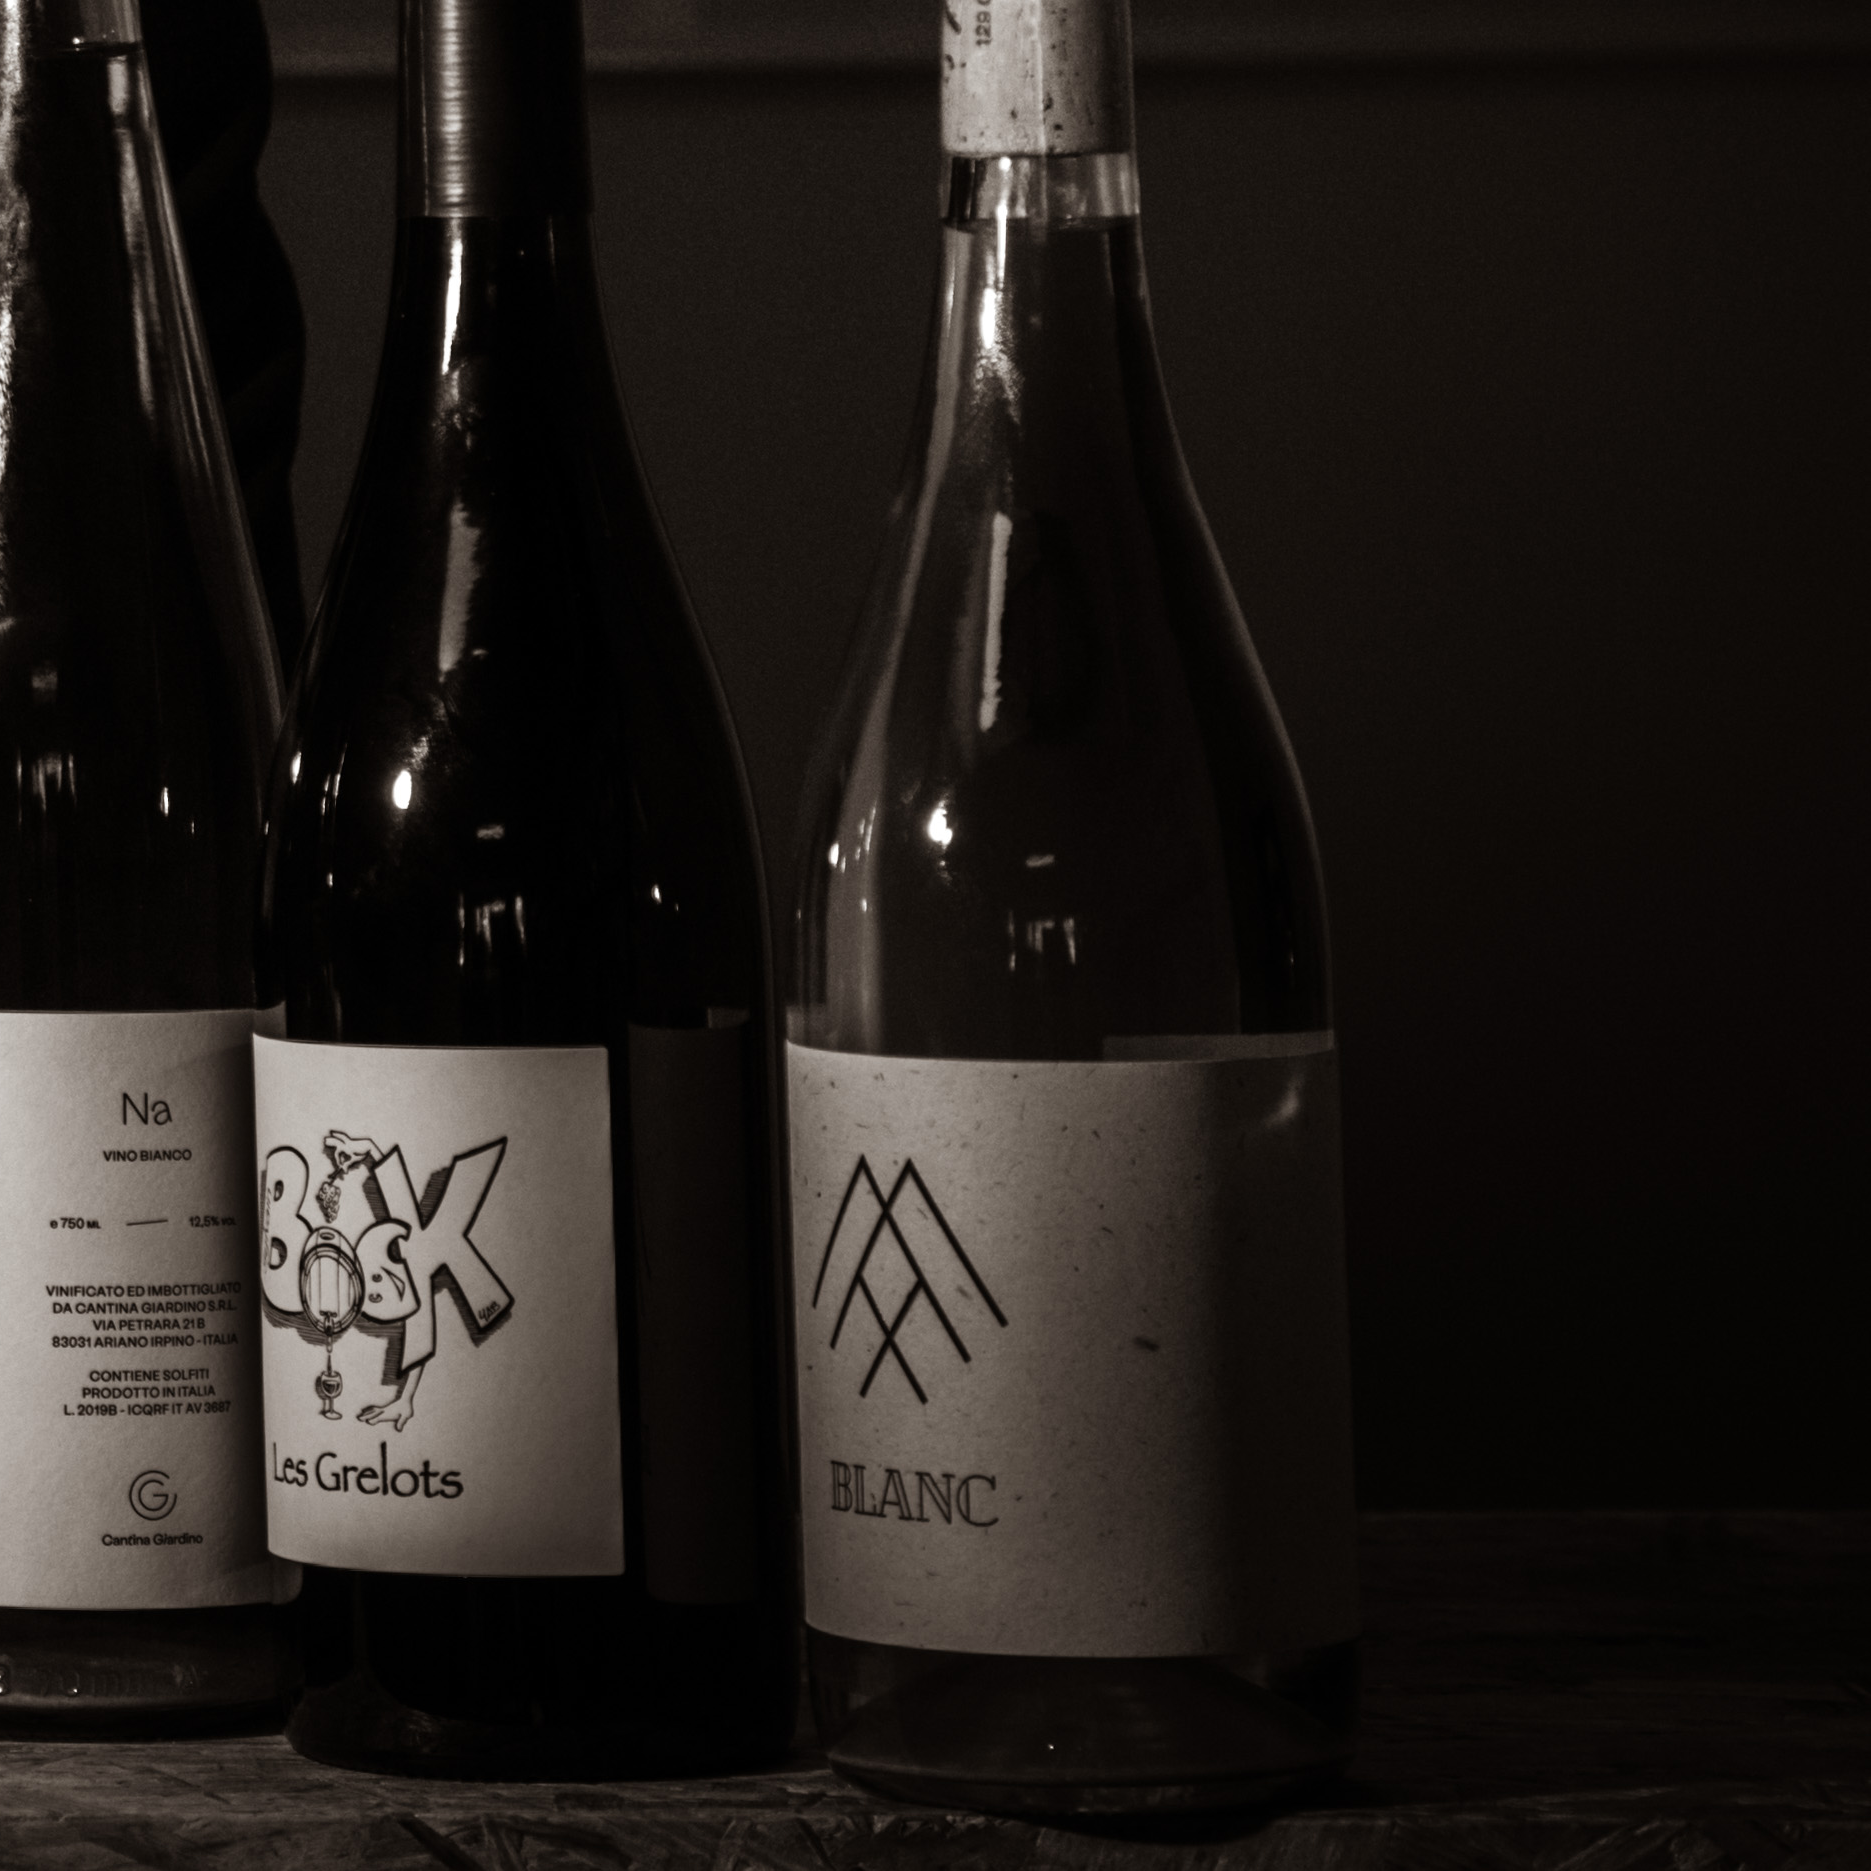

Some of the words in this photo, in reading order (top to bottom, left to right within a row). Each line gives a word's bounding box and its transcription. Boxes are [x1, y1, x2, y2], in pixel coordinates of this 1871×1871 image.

[122, 1091, 173, 1126] Na
[102, 1149, 138, 1163] VINO
[140, 1148, 193, 1162] BIANCO
[60, 1216, 85, 1230] 750
[45, 1284, 125, 1298] VINIFICATO
[126, 1284, 146, 1298] ED
[147, 1281, 242, 1297] IMBOTTIGLIATO
[52, 1301, 73, 1315] DA
[75, 1301, 139, 1315] CANTINA
[140, 1300, 206, 1315] GIARDINO
[92, 1319, 116, 1332] VIA
[118, 1318, 181, 1332] PETRARA
[51, 1335, 92, 1349] 83031
[93, 1335, 149, 1349] ARIANO
[150, 1334, 195, 1348] IRPINO
[203, 1332, 240, 1346] ITALIA
[88, 1369, 161, 1383] CONTIENE
[162, 1368, 210, 1382] SOLFITI
[82, 1386, 160, 1400] PRODOTTO
[162, 1386, 175, 1399] IN
[177, 1385, 216, 1398] ITALIA
[63, 1404, 75, 1416] L.
[77, 1403, 118, 1416] 2019B
[127, 1403, 171, 1417] ICQRF
[172, 1402, 183, 1415] IT
[185, 1402, 203, 1415] AV
[271, 1440, 310, 1488] Les
[314, 1440, 465, 1500] Grelots
[829, 1458, 1000, 1530] BLANC
[101, 1533, 151, 1547] Cantina
[152, 1532, 204, 1547] Giardino
